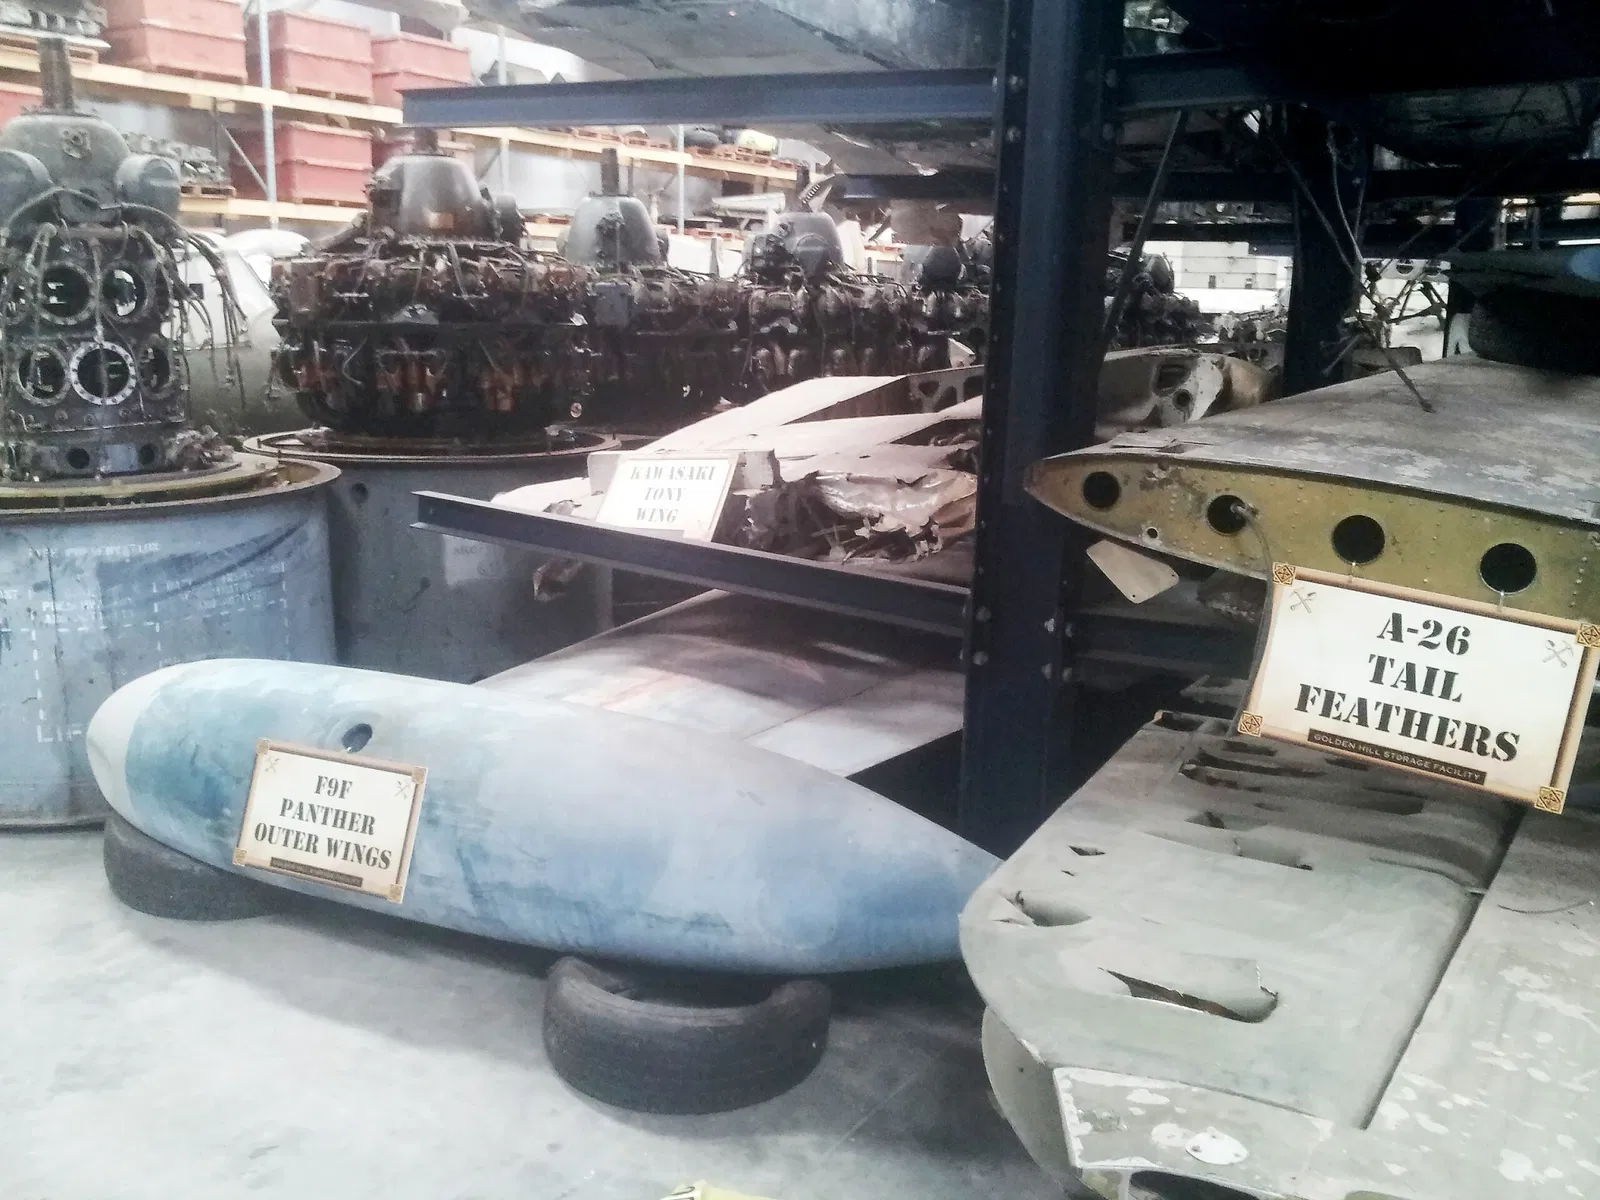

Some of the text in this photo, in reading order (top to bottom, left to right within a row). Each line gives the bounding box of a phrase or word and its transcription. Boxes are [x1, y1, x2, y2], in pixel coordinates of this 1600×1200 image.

[630, 465, 716, 481] KAWASAKI
[636, 507, 679, 524] WING
[644, 487, 686, 502] TONY
[1376, 611, 1472, 656] A-26
[1368, 653, 1464, 703] TAIL
[1294, 683, 1521, 762] FEATHERS
[1313, 732, 1481, 781] GOLDEN HILL STORAGE FACILITY
[315, 775, 353, 800] F9F
[279, 797, 376, 836] PANTHER
[254, 822, 392, 870] OUTER WINGS
